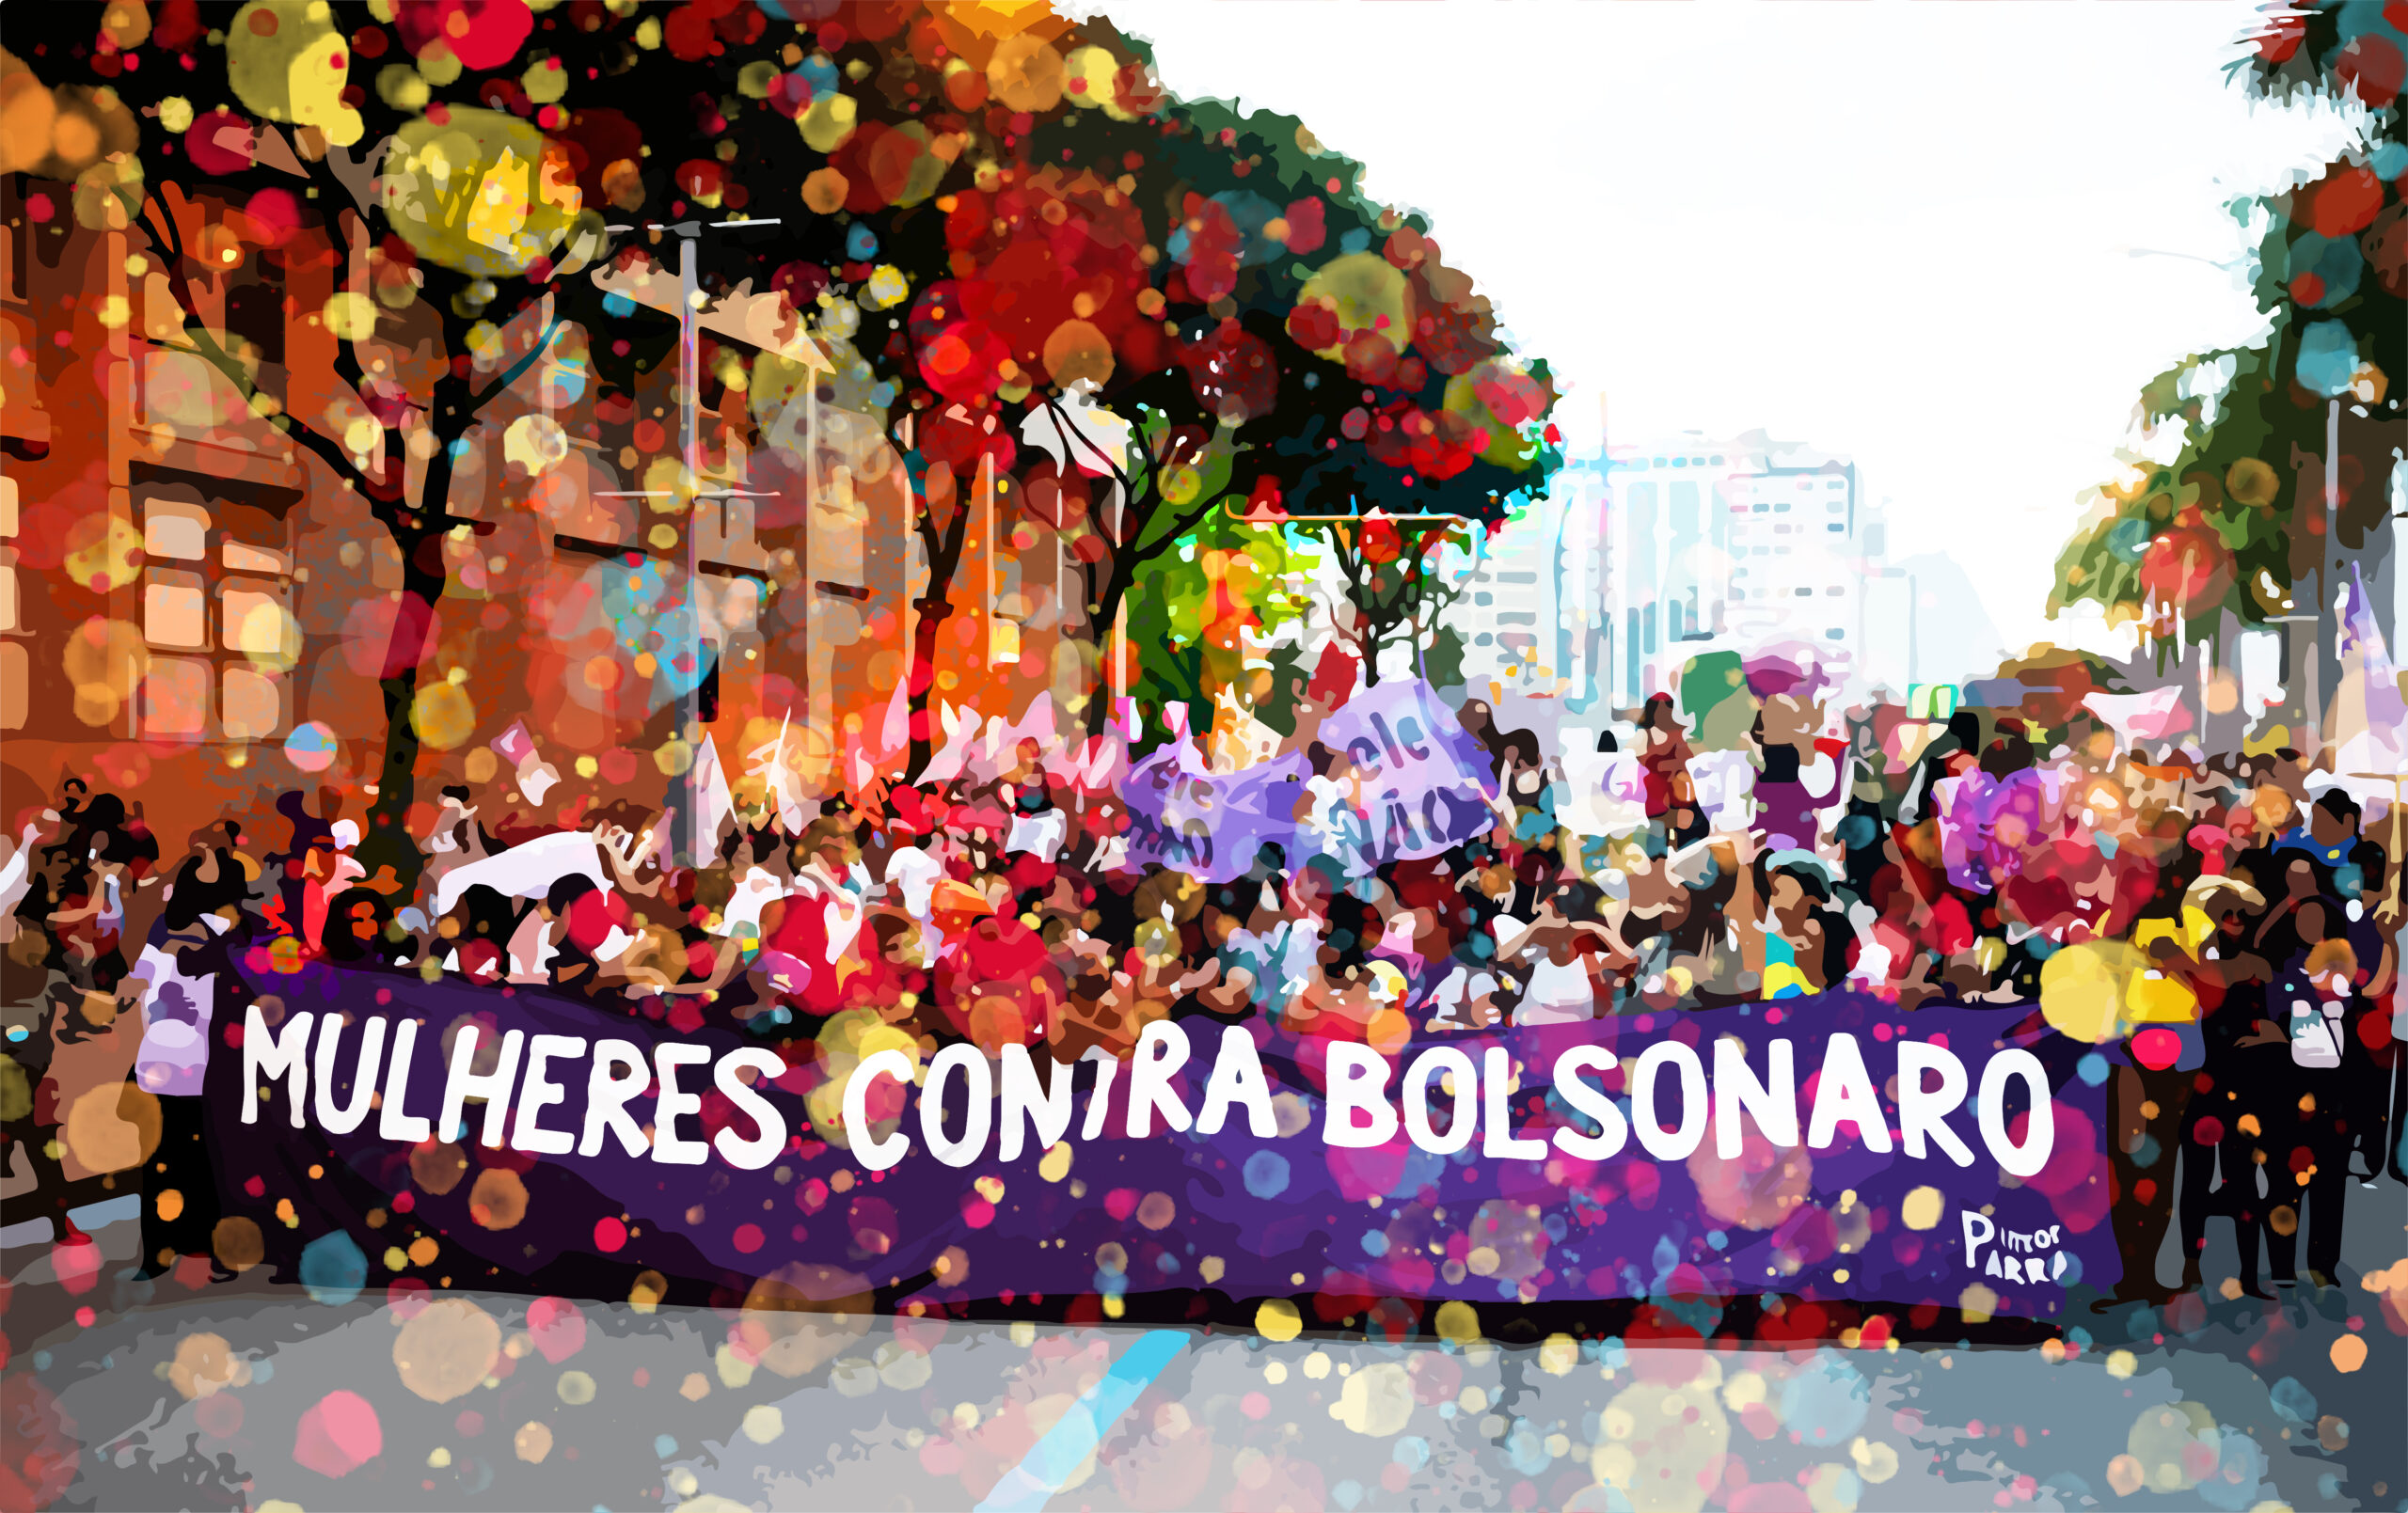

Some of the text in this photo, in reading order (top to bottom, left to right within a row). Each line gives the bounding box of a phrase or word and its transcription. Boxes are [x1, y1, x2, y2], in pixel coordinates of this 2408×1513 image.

[241, 1004, 2054, 1177] MULHERES CONTRA BOLSONARO
